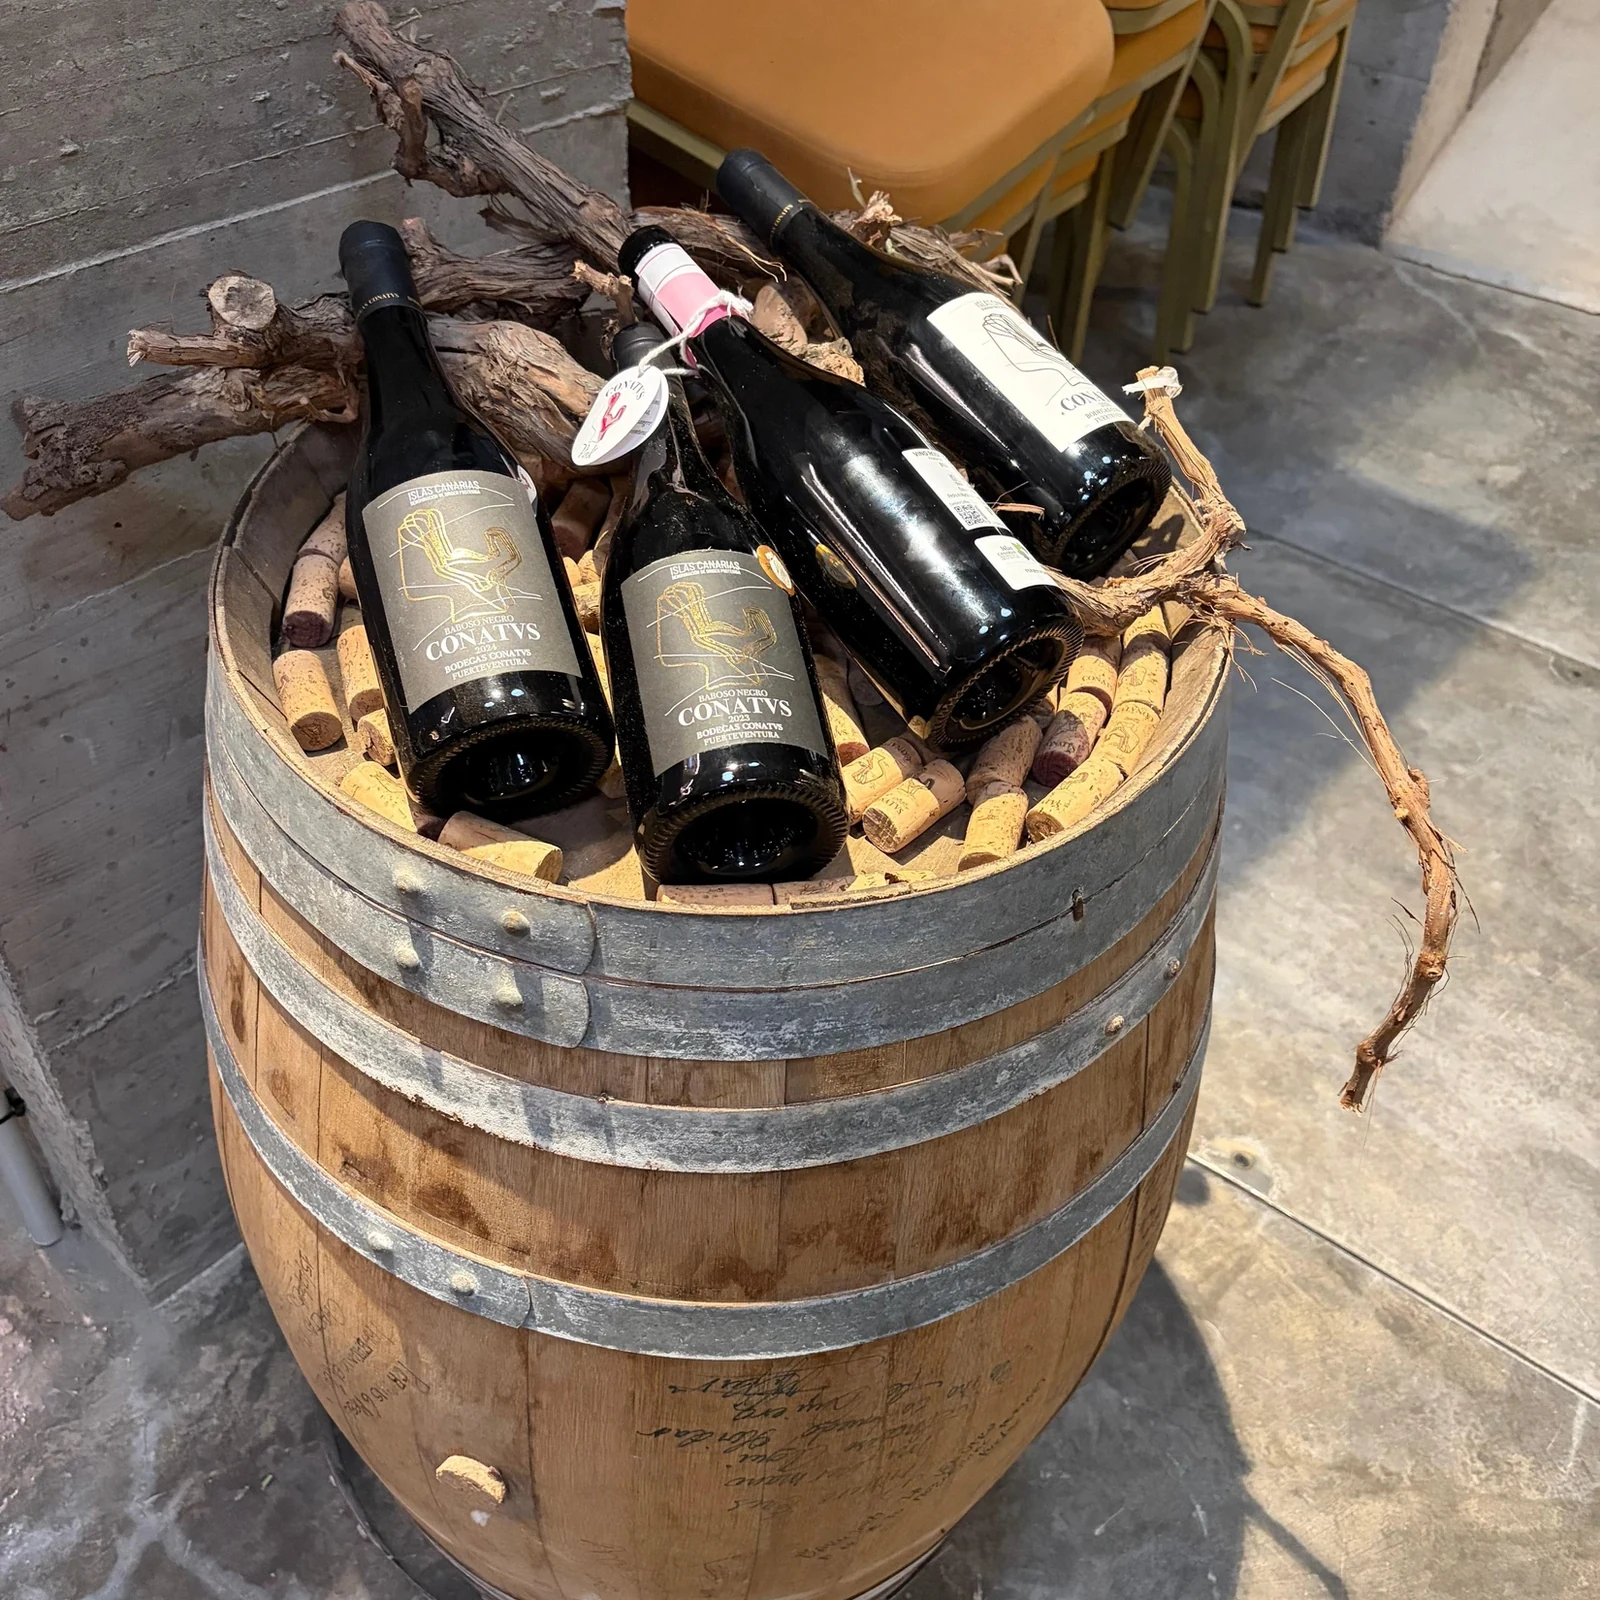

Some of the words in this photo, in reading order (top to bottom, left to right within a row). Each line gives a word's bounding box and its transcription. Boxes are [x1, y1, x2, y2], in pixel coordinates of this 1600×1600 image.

[605, 379, 646, 401] CONATVS
[407, 486, 434, 502] ISLAS
[434, 480, 480, 494] CANARIAS
[669, 562, 695, 576] ISLAS
[696, 559, 741, 570] CANARIAS
[443, 619, 481, 636] BABOSO
[482, 614, 515, 626] NEGRO
[425, 622, 541, 661] CONATVS
[474, 643, 497, 654] 2024
[444, 653, 488, 674] BODEGAS
[488, 648, 532, 660] CONATVS
[451, 657, 529, 681] FUERTEVENTURA
[698, 690, 736, 703] BABOSO
[735, 688, 768, 697] NEGRO
[677, 696, 792, 727] CONATVS
[728, 714, 751, 723] 2023
[696, 723, 741, 740] BODEGAS
[742, 721, 784, 731] CONATVS
[703, 730, 780, 747] FUERTEVENTURA
